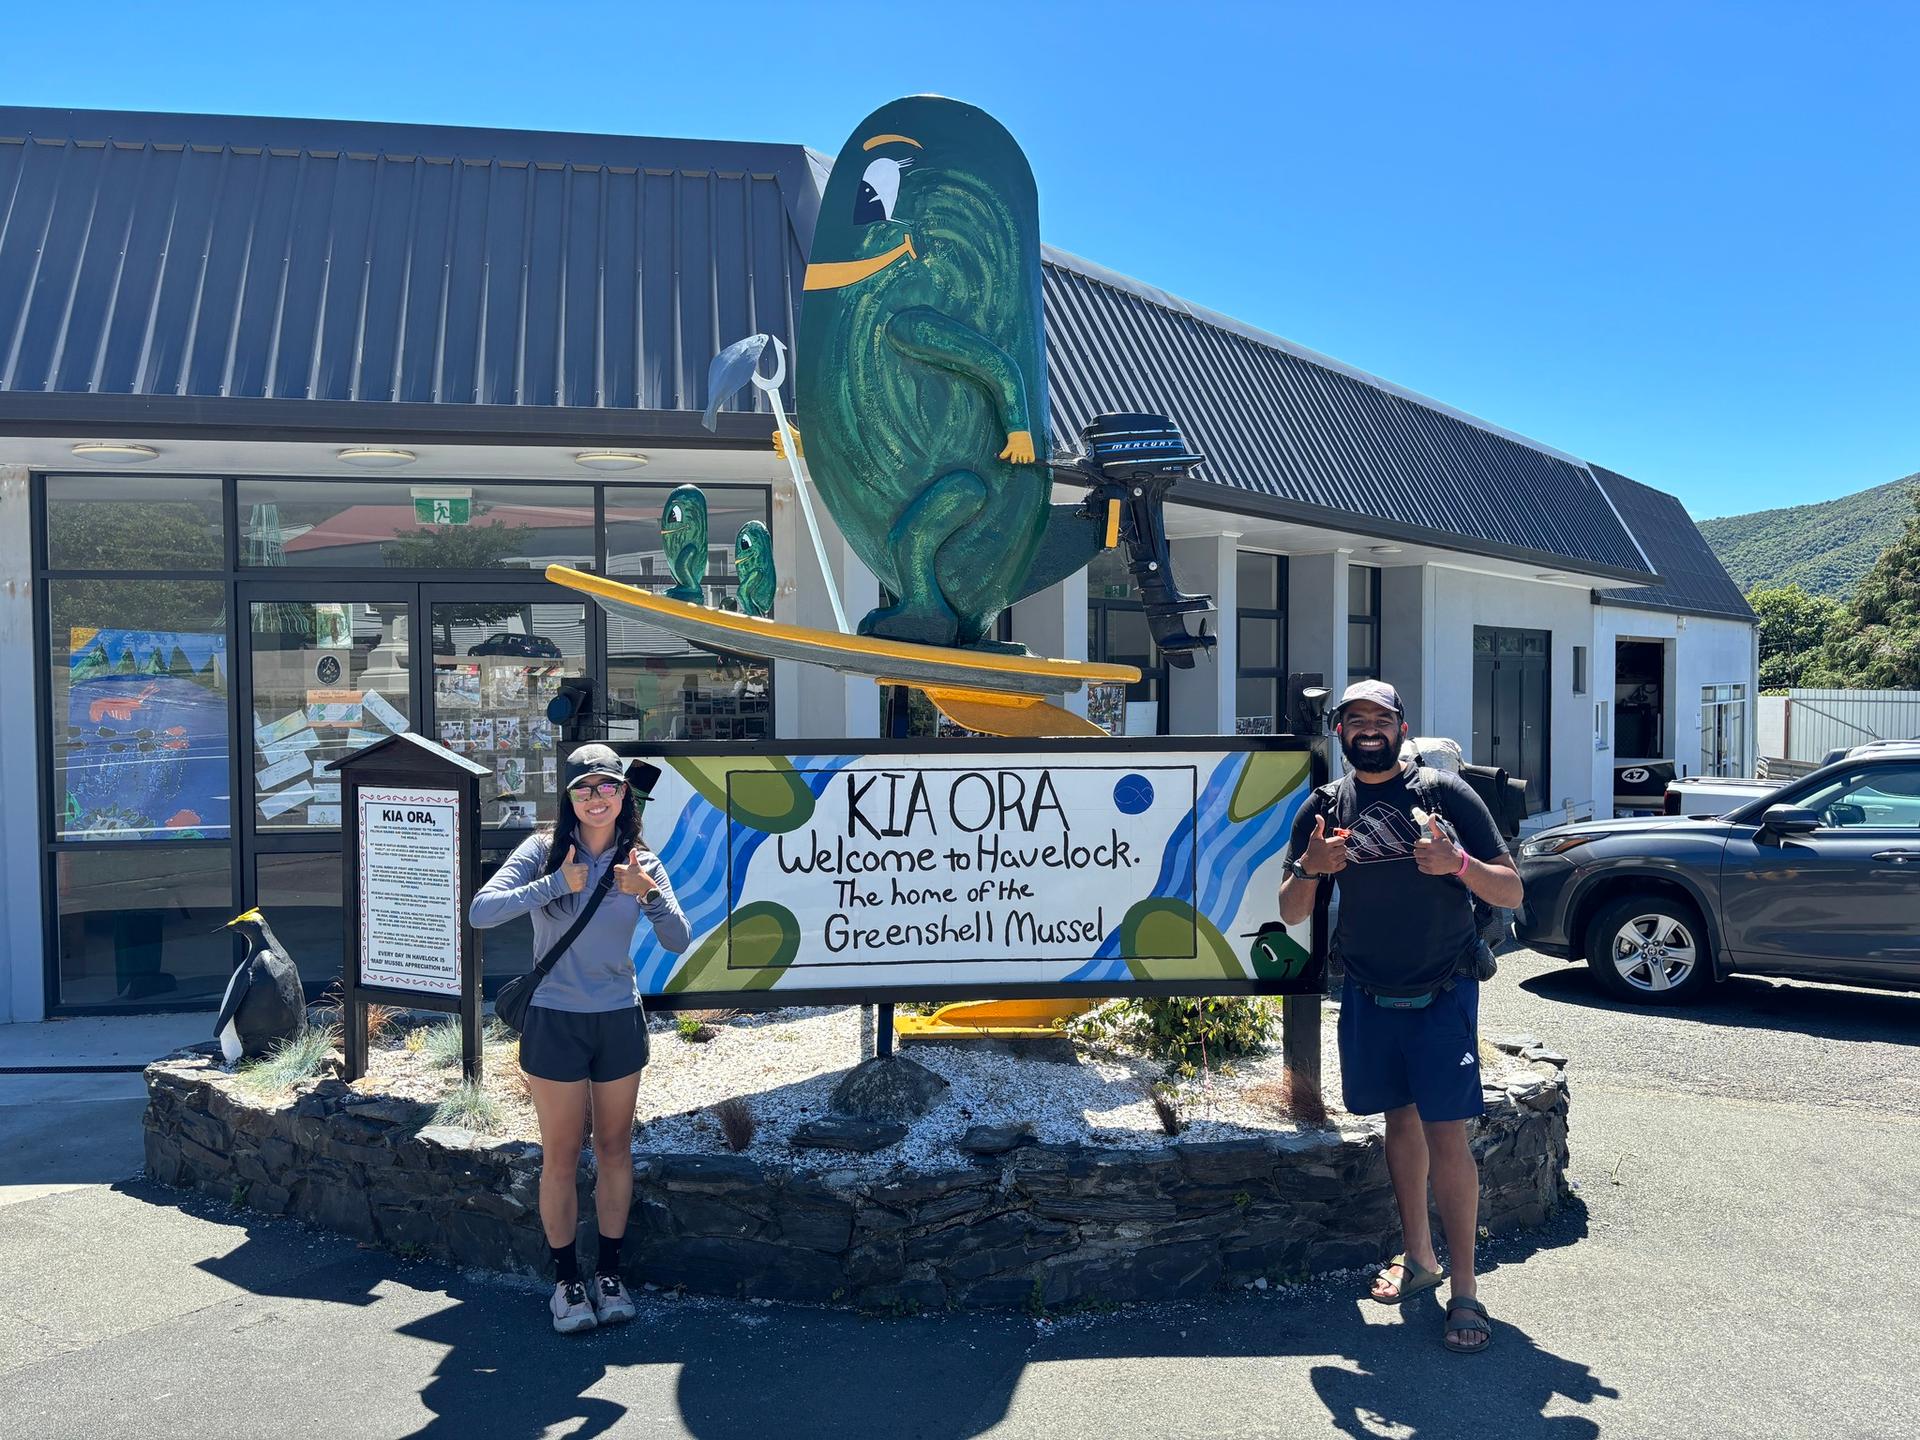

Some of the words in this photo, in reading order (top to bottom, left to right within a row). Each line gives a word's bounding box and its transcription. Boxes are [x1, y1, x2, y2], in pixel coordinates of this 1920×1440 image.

[1111, 441, 1173, 450] MERCURY
[1624, 771, 1645, 780] 47
[847, 772, 938, 839] KIA
[949, 769, 1071, 834] ORA
[382, 809, 404, 823] KIA
[407, 811, 436, 827] ORA,
[777, 830, 936, 875] Welcome
[942, 847, 971, 873] to
[977, 828, 1141, 875] Havelock.
[833, 878, 884, 909] The
[891, 878, 958, 908] home
[967, 881, 996, 903] of
[996, 878, 1035, 901] the
[823, 913, 994, 953] Greenshell
[1004, 906, 1104, 947] Mussel
[378, 950, 394, 958] EVERY
[412, 953, 439, 962] HAVELOCK
[384, 959, 404, 967] MUSSEL
[405, 961, 441, 971] APPRECIATION
